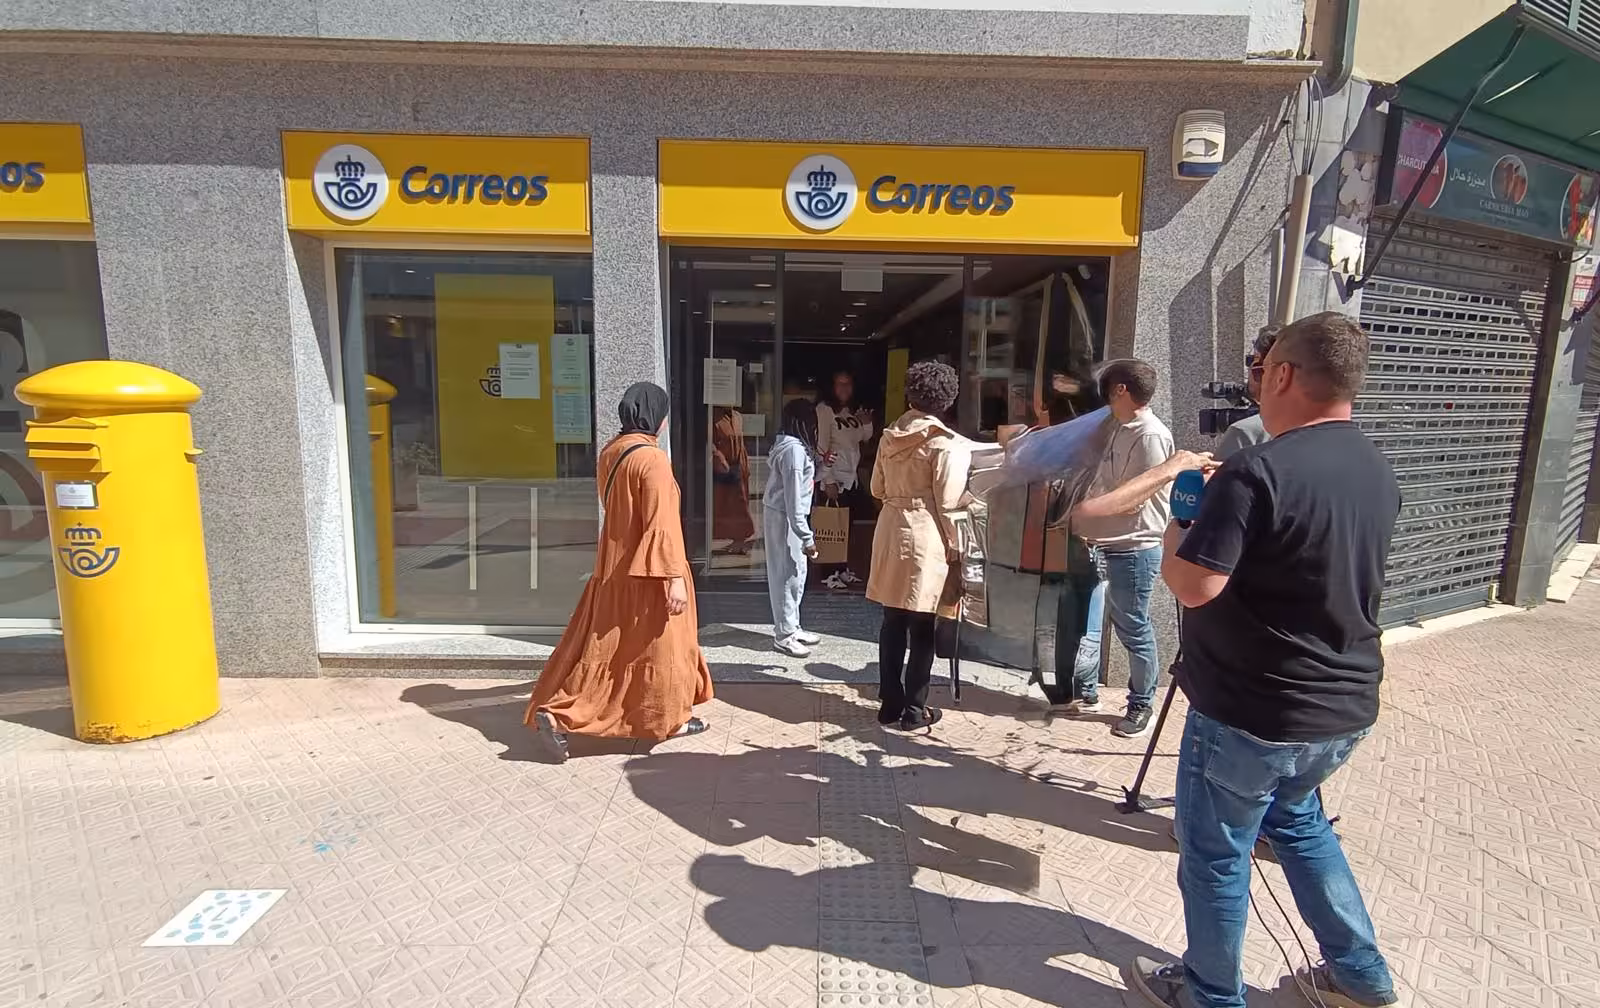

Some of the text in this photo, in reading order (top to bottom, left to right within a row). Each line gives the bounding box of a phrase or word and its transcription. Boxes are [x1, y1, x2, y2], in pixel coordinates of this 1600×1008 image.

[401, 165, 549, 201] Correos
[870, 175, 1016, 212] Correos
[1174, 488, 1197, 506] tve
